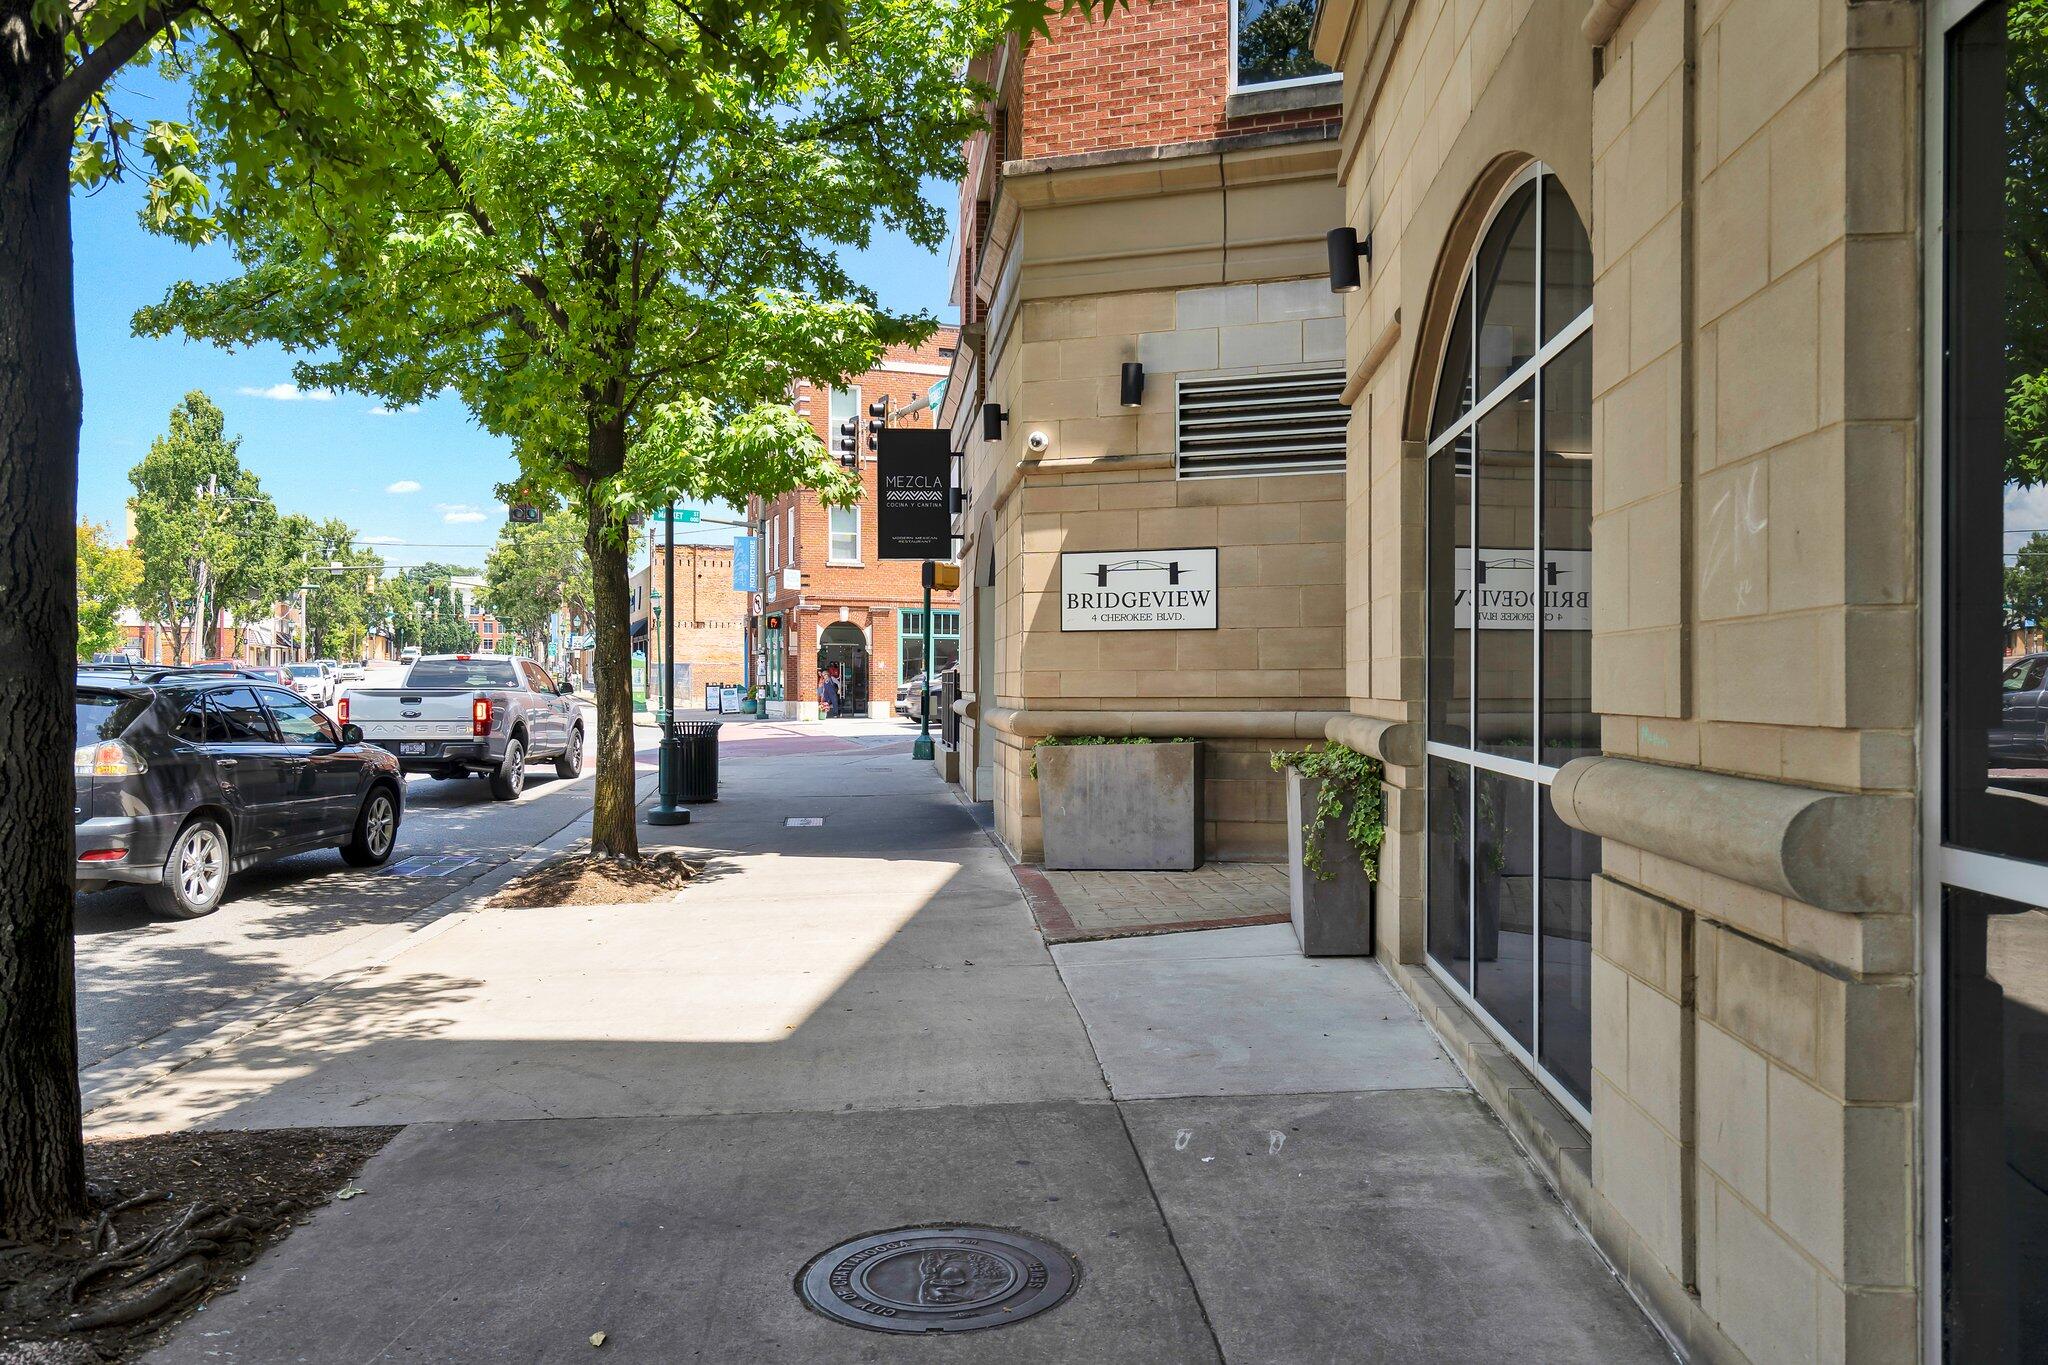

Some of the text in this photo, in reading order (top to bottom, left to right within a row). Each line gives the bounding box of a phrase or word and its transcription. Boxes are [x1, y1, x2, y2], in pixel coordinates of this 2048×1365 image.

[886, 475, 943, 488] MEZCLA
[1066, 589, 1212, 610] BRIDGEVIEW
[1091, 612, 1186, 622] 4 CHEROKEE BLVD.
[832, 1240, 912, 1317] CITY OF CHATTANOOGA
[1028, 1261, 1046, 1289] SEWER
